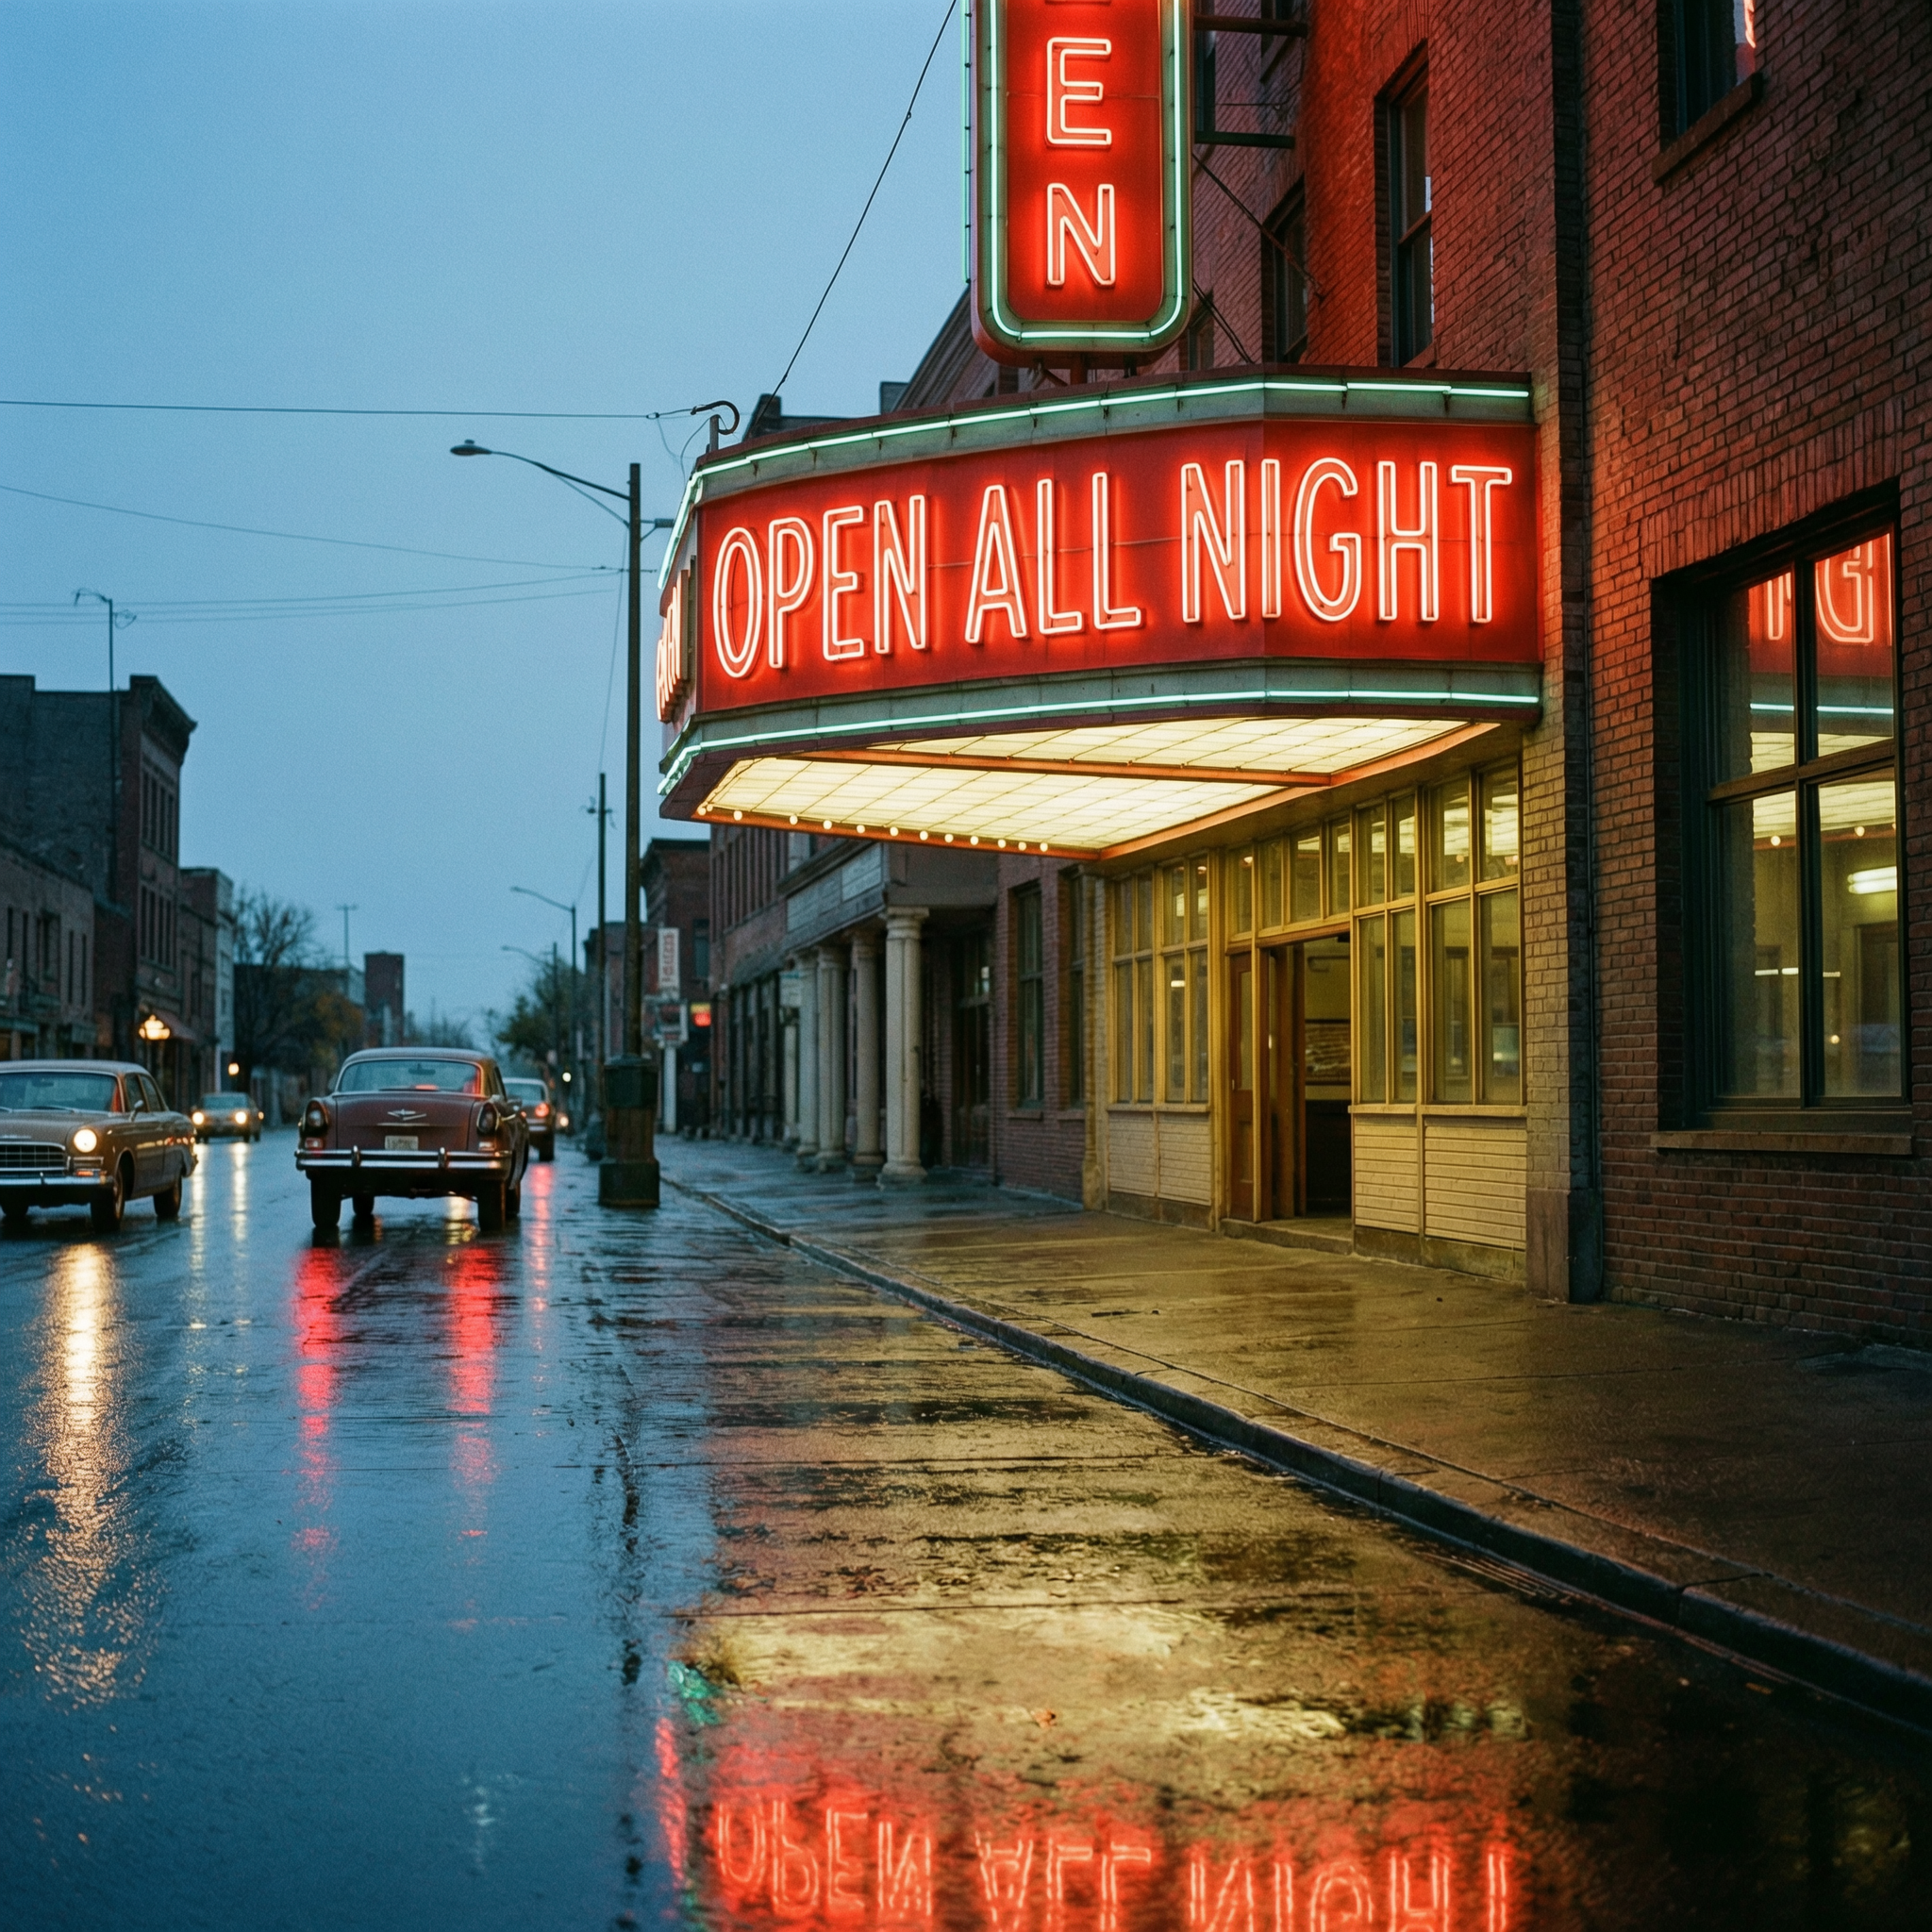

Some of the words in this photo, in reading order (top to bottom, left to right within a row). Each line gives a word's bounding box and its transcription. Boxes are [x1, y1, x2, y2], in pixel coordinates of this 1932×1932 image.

[1044, 0, 1116, 287] EN
[712, 494, 926, 678] OPEN
[965, 472, 1142, 644] ALL
[1181, 458, 1512, 623] NIGHT
